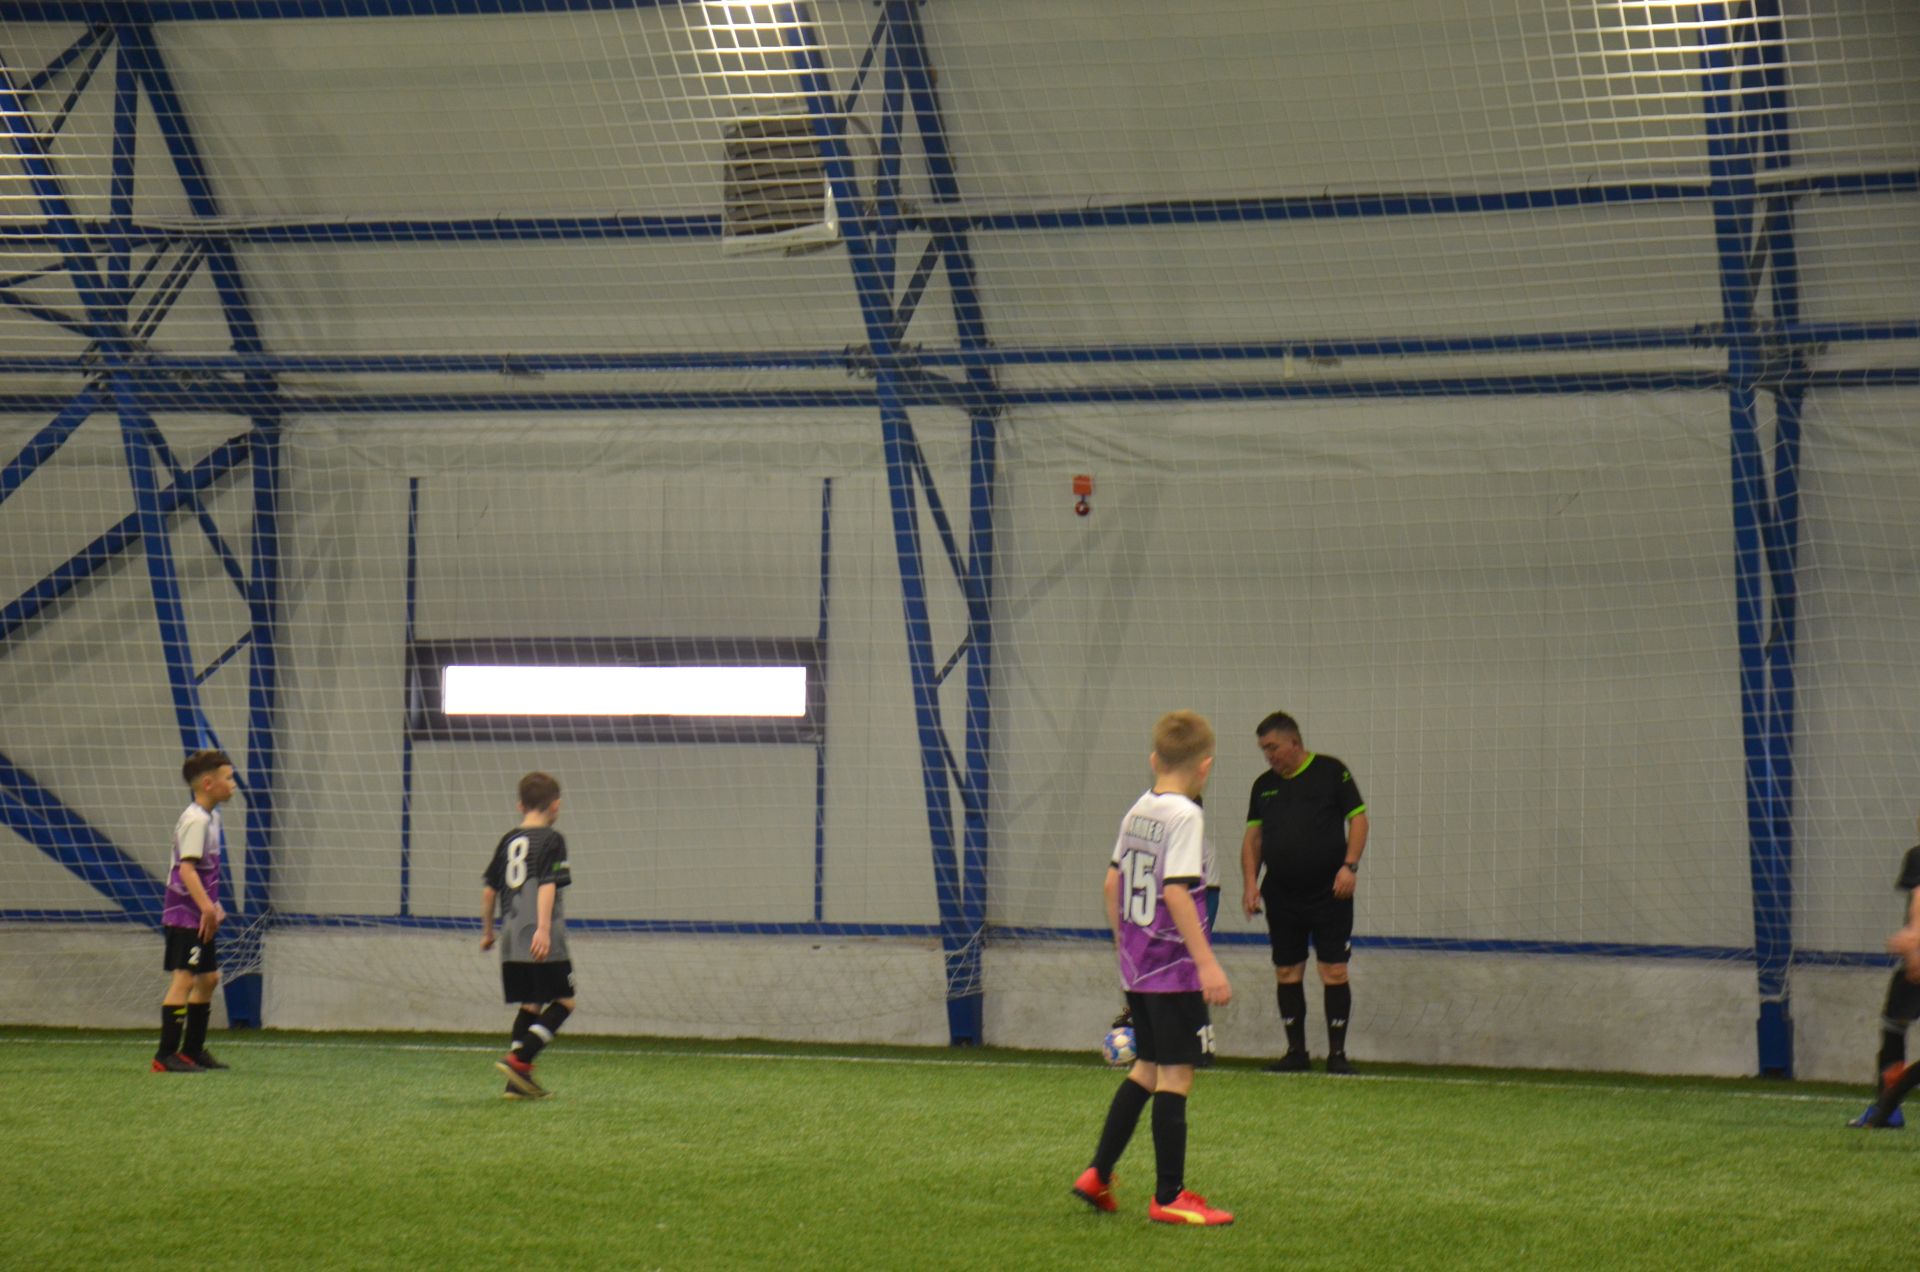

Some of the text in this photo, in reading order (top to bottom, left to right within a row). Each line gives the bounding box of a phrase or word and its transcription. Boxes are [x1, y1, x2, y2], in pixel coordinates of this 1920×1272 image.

[505, 835, 530, 889] 8
[1121, 848, 1157, 927] 15
[188, 946, 202, 965] 2
